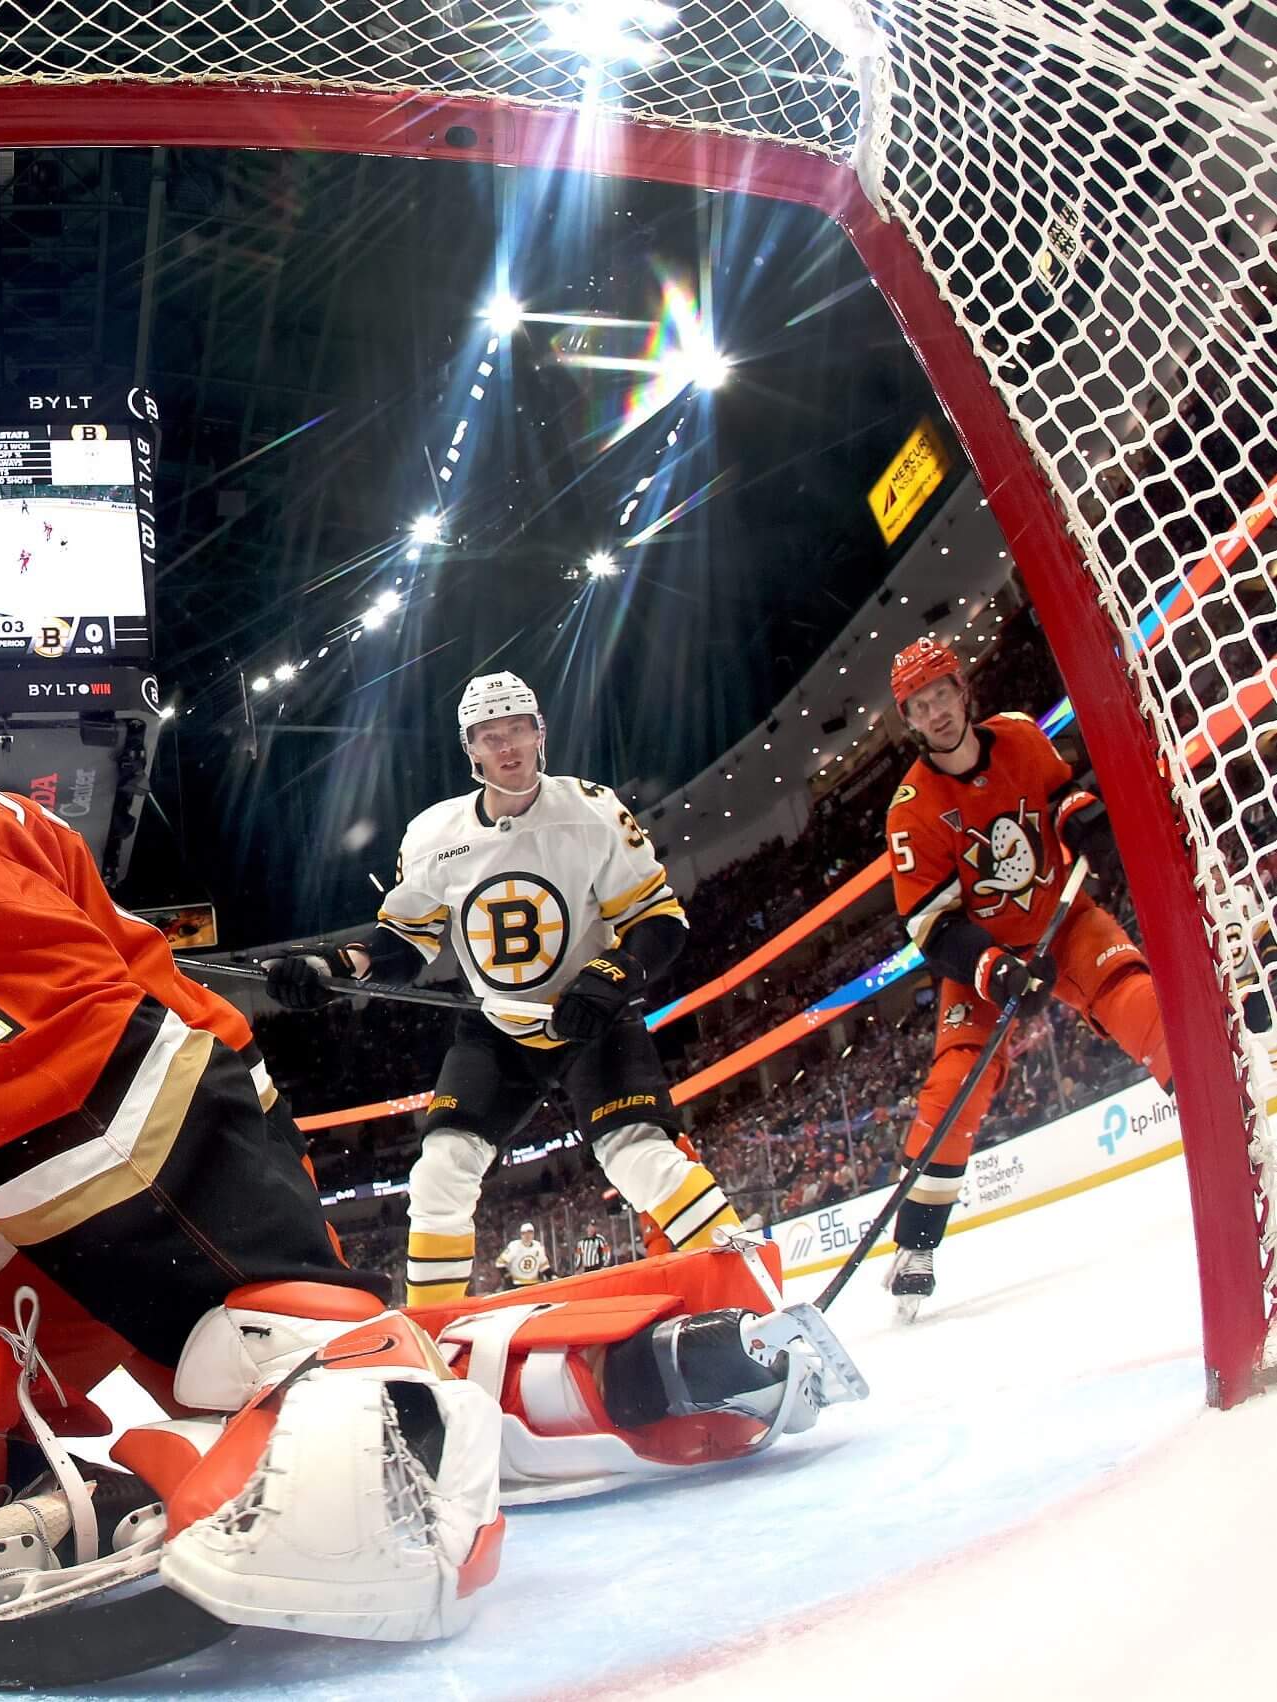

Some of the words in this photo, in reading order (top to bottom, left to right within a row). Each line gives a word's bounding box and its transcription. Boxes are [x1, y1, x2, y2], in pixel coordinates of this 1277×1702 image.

[29, 396, 93, 409] BYLT
[136, 438, 153, 503] BYLT
[84, 623, 104, 643] 0
[486, 680, 504, 690] 39
[890, 831, 916, 873] 5
[486, 899, 541, 966] B
[590, 1095, 657, 1123] BAUER
[974, 1154, 999, 1171] Rady
[979, 1183, 1012, 1204] Health
[818, 1208, 845, 1232] OC
[820, 1220, 878, 1252] SOLA
